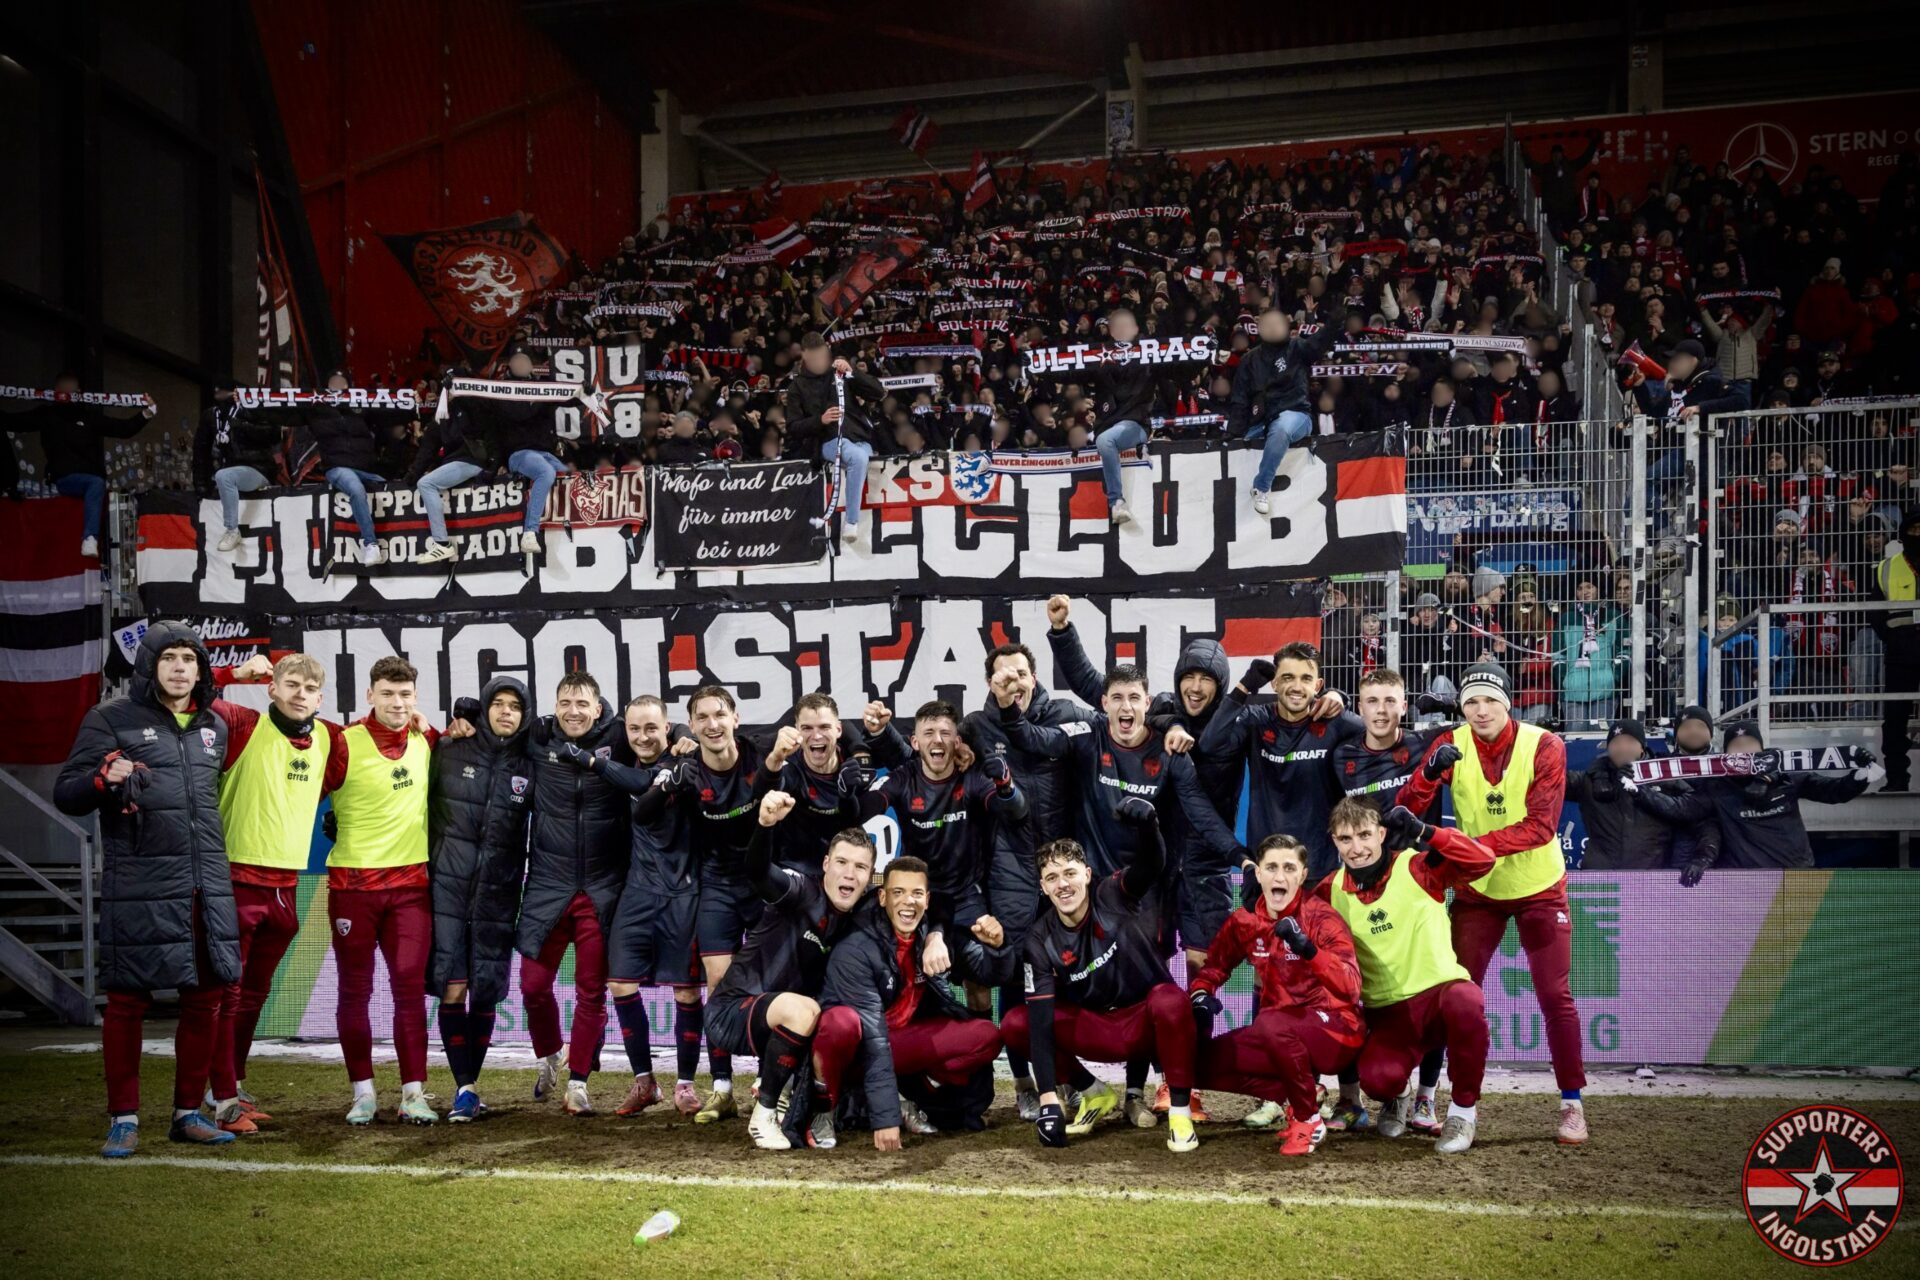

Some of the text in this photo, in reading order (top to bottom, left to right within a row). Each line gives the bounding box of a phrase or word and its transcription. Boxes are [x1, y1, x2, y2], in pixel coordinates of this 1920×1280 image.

[1808, 128, 1888, 155] STERN
[933, 299, 1014, 316] SCHANZER
[526, 336, 575, 347] SCHANZER
[1335, 344, 1351, 352] ALL
[884, 377, 925, 387] INGOLSTADT
[491, 384, 512, 394] UND
[514, 385, 577, 397] INGOLSTADT
[660, 466, 820, 501] Mofo und Lars
[334, 481, 524, 519] SPPOTERS
[678, 506, 797, 534] für immer
[334, 526, 525, 564] INGOLTADT
[696, 539, 781, 560] bei uns
[181, 617, 250, 640] ektion
[1468, 672, 1504, 688] errea
[1791, 747, 1843, 771] RA
[287, 771, 309, 782] errea
[393, 778, 414, 791] errea
[1486, 804, 1507, 816] errea
[1370, 921, 1394, 936] errea
